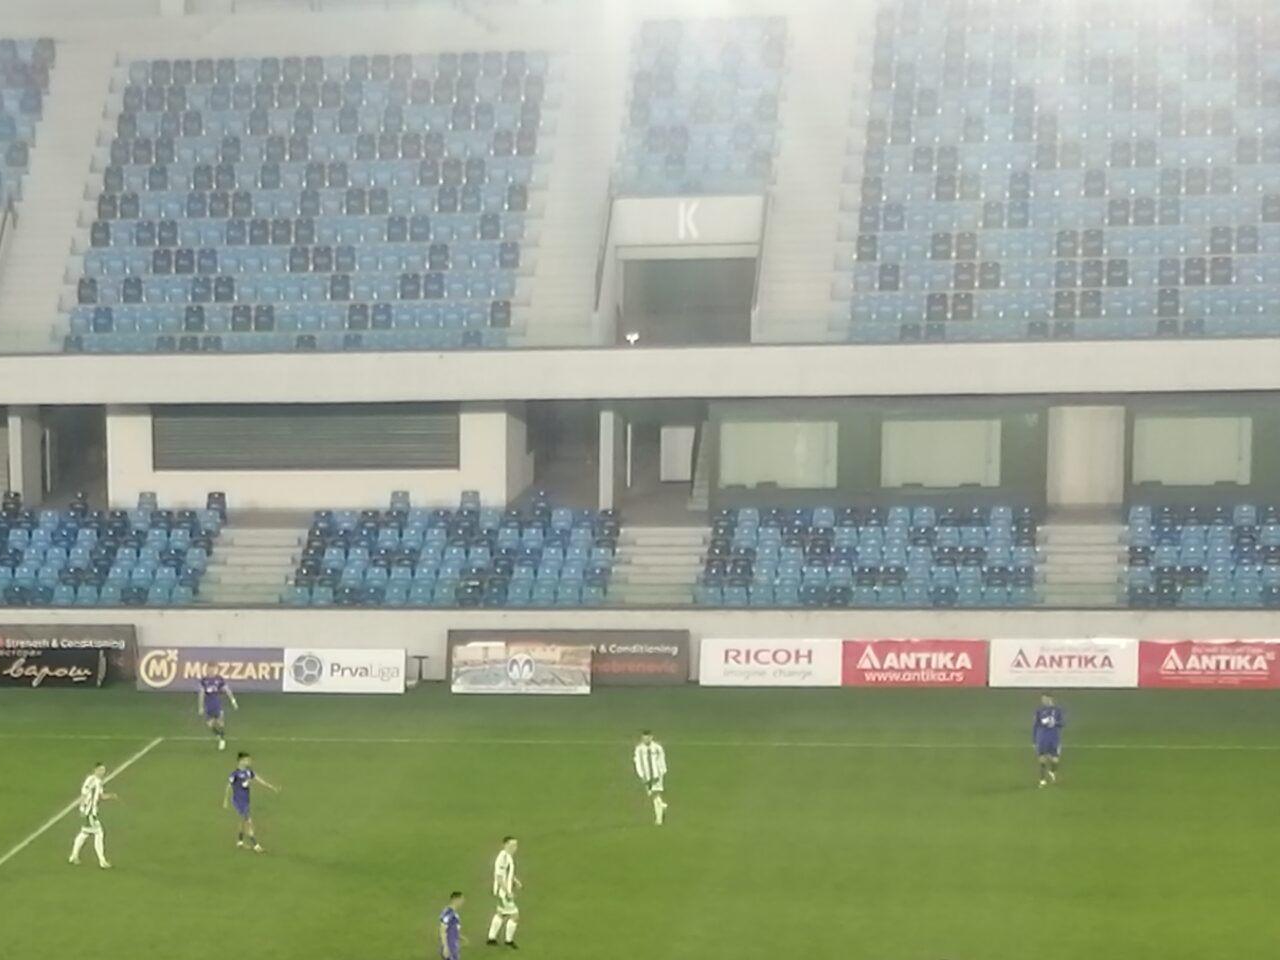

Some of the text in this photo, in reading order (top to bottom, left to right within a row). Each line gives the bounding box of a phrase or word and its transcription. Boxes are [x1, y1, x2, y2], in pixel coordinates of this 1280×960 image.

[678, 201, 700, 240] K
[609, 643, 678, 656] Conditioning
[724, 648, 812, 665] RICOH
[883, 652, 972, 669] ANTIKA
[1034, 655, 1114, 668] ANTIKA
[1186, 655, 1268, 670] ANTIKA
[330, 662, 400, 682] PrvaLiga
[864, 670, 964, 682] www.antika.rs
